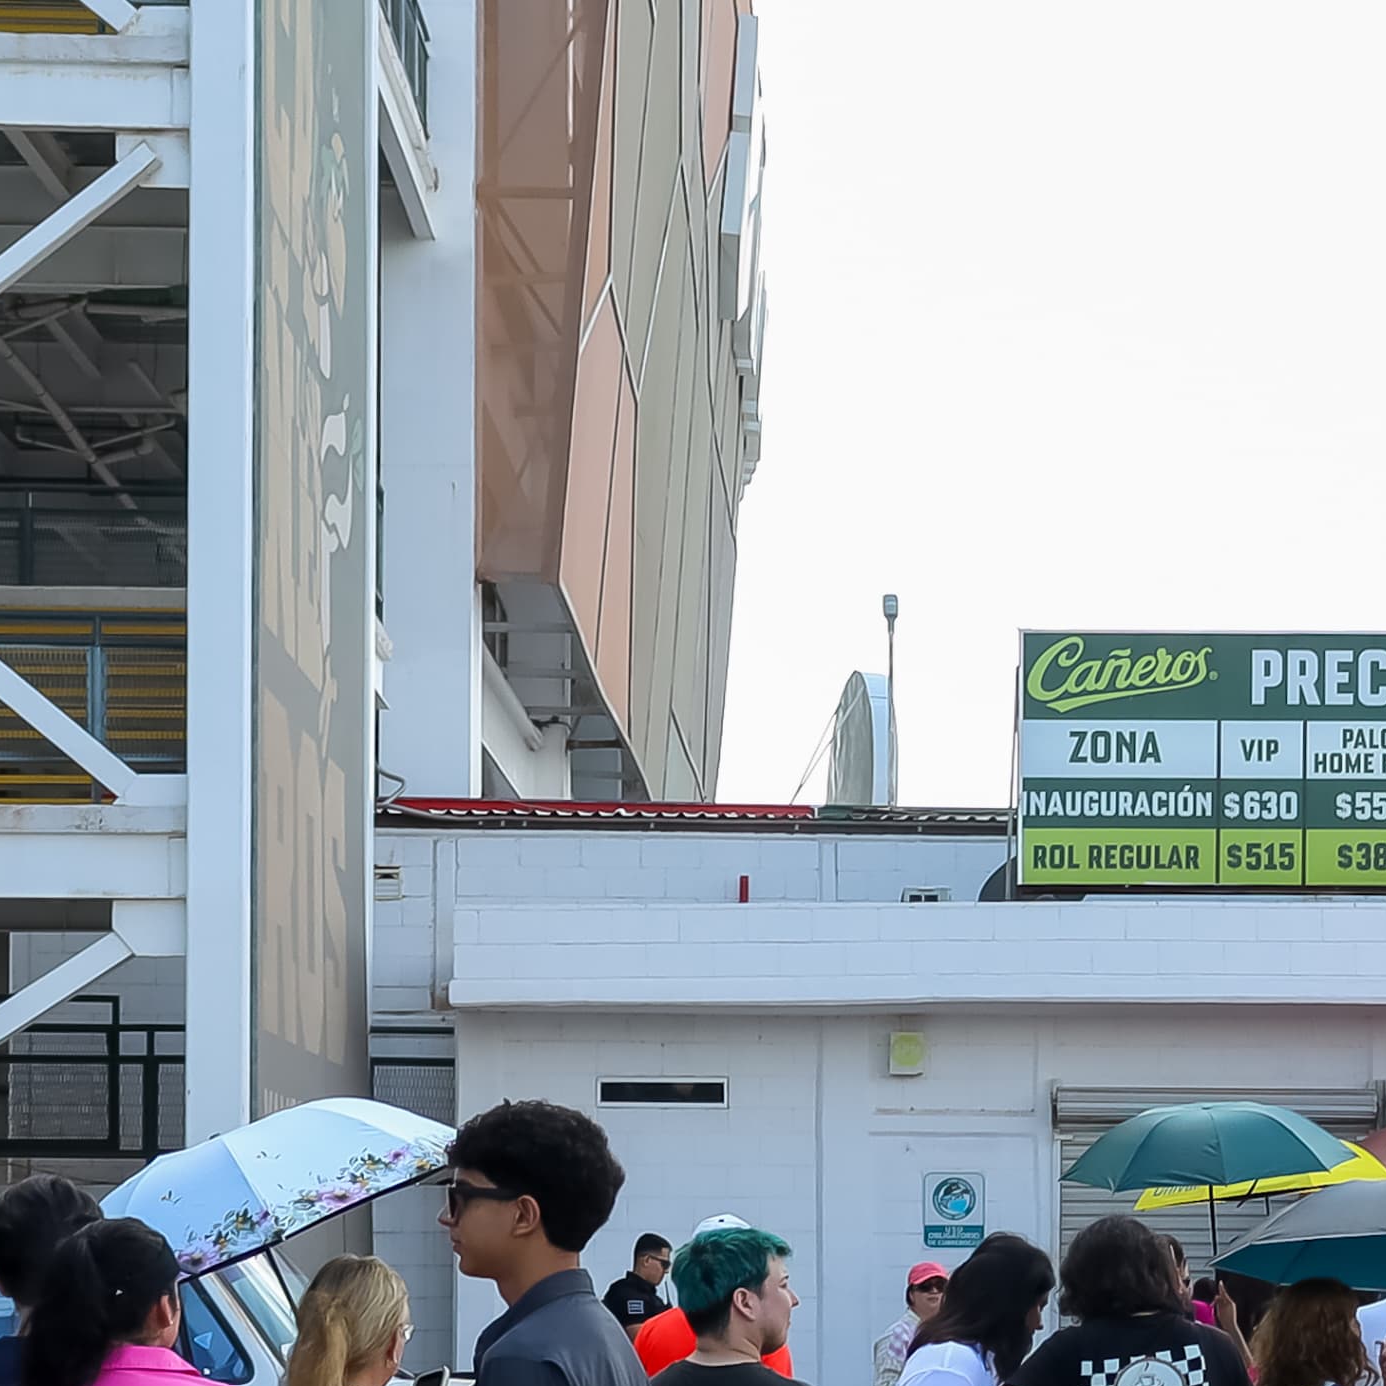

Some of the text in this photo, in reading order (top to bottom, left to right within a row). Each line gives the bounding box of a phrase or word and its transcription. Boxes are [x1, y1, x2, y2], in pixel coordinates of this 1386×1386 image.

[1027, 635, 1212, 713] Cañeros
[1068, 730, 1162, 764] ZONA
[1240, 738, 1279, 762] VIP
[1313, 753, 1376, 775] HOME
[1022, 784, 1213, 817] INAUGURACIÓN
[1224, 791, 1298, 822] $630
[1033, 845, 1080, 870] ROL
[1088, 845, 1200, 870] REGULAR
[1226, 843, 1296, 872] $515
